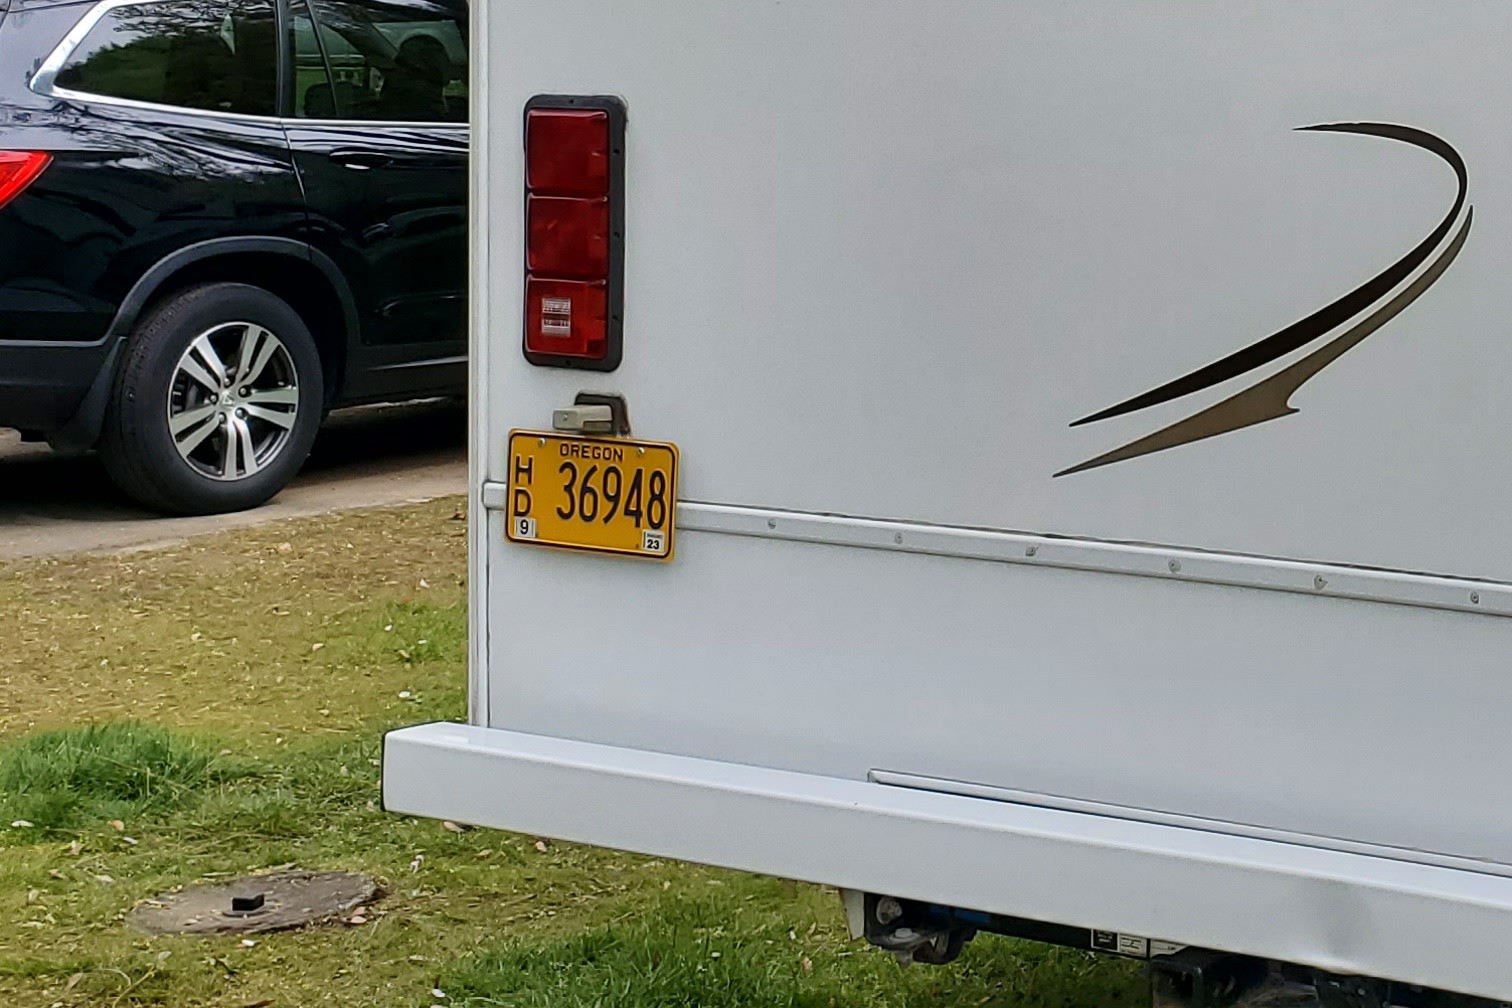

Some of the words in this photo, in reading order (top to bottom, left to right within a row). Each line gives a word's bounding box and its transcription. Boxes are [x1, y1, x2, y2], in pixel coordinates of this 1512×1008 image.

[559, 442, 624, 463] OREGON
[556, 460, 667, 530] 36948
[519, 518, 529, 535] 9
[646, 538, 660, 550] 23
